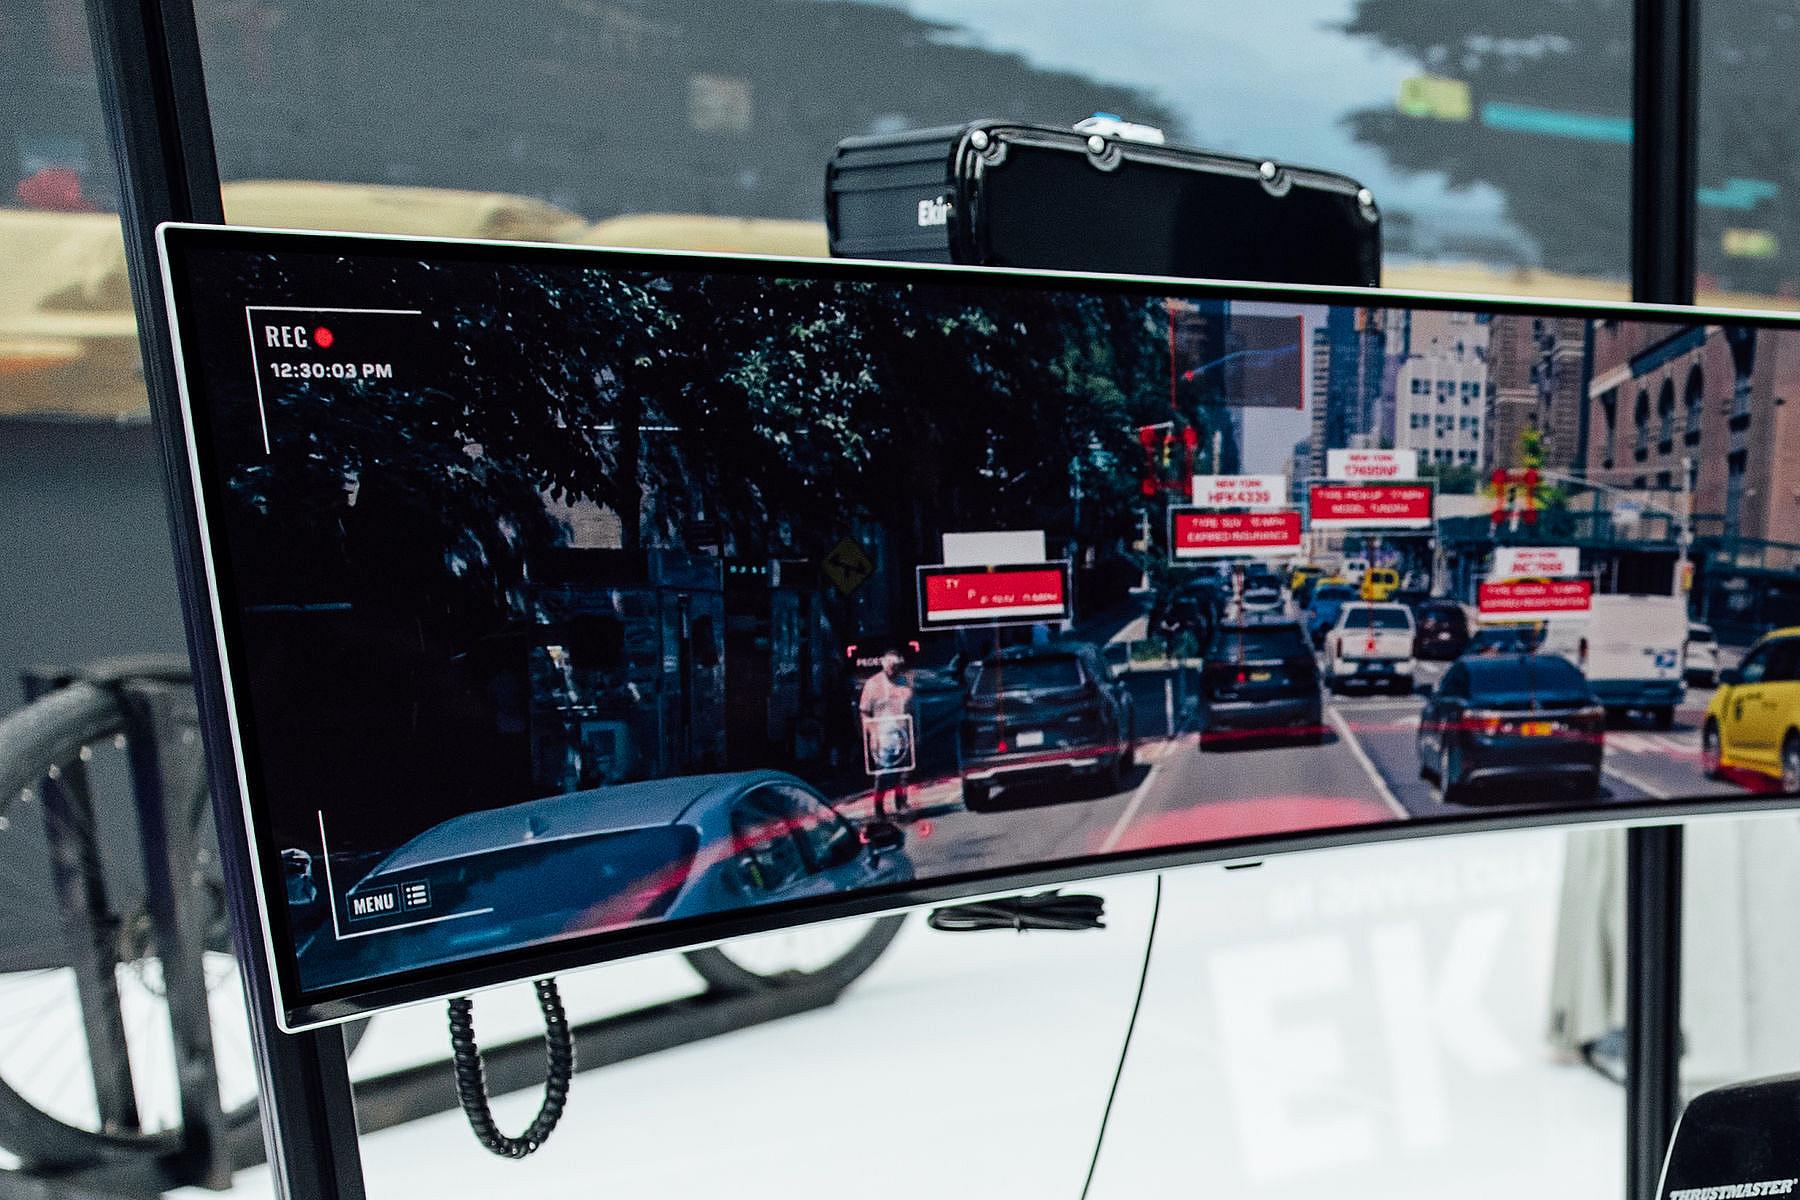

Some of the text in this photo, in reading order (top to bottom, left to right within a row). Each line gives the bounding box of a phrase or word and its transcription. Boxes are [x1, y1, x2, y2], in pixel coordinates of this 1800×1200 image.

[265, 325, 308, 348] REC
[270, 362, 393, 379] 12:30:03 PM
[353, 893, 394, 915] MENU
